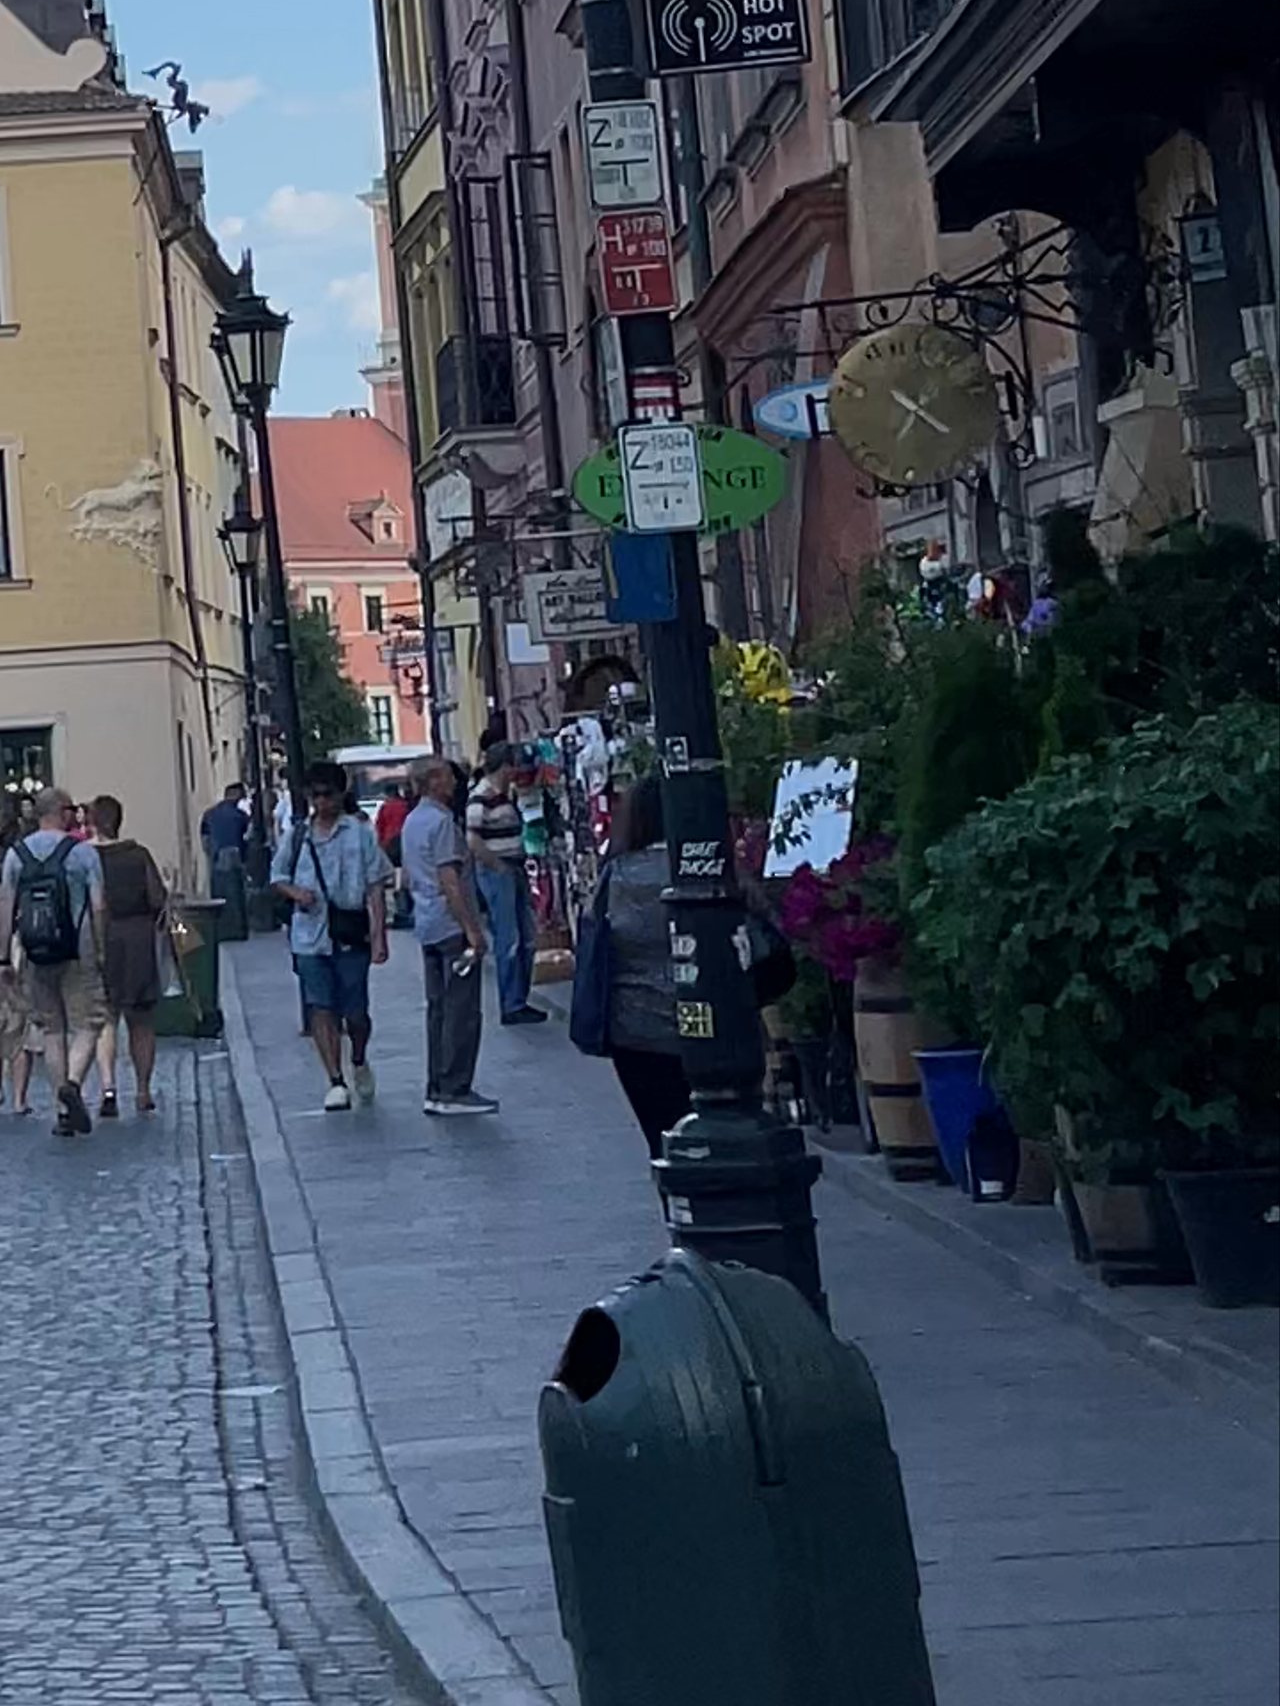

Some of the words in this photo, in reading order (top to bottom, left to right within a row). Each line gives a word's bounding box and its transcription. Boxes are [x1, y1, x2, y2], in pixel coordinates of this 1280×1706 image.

[742, 21, 795, 44] SPOT
[600, 223, 622, 253] H
[627, 441, 649, 470] Z
